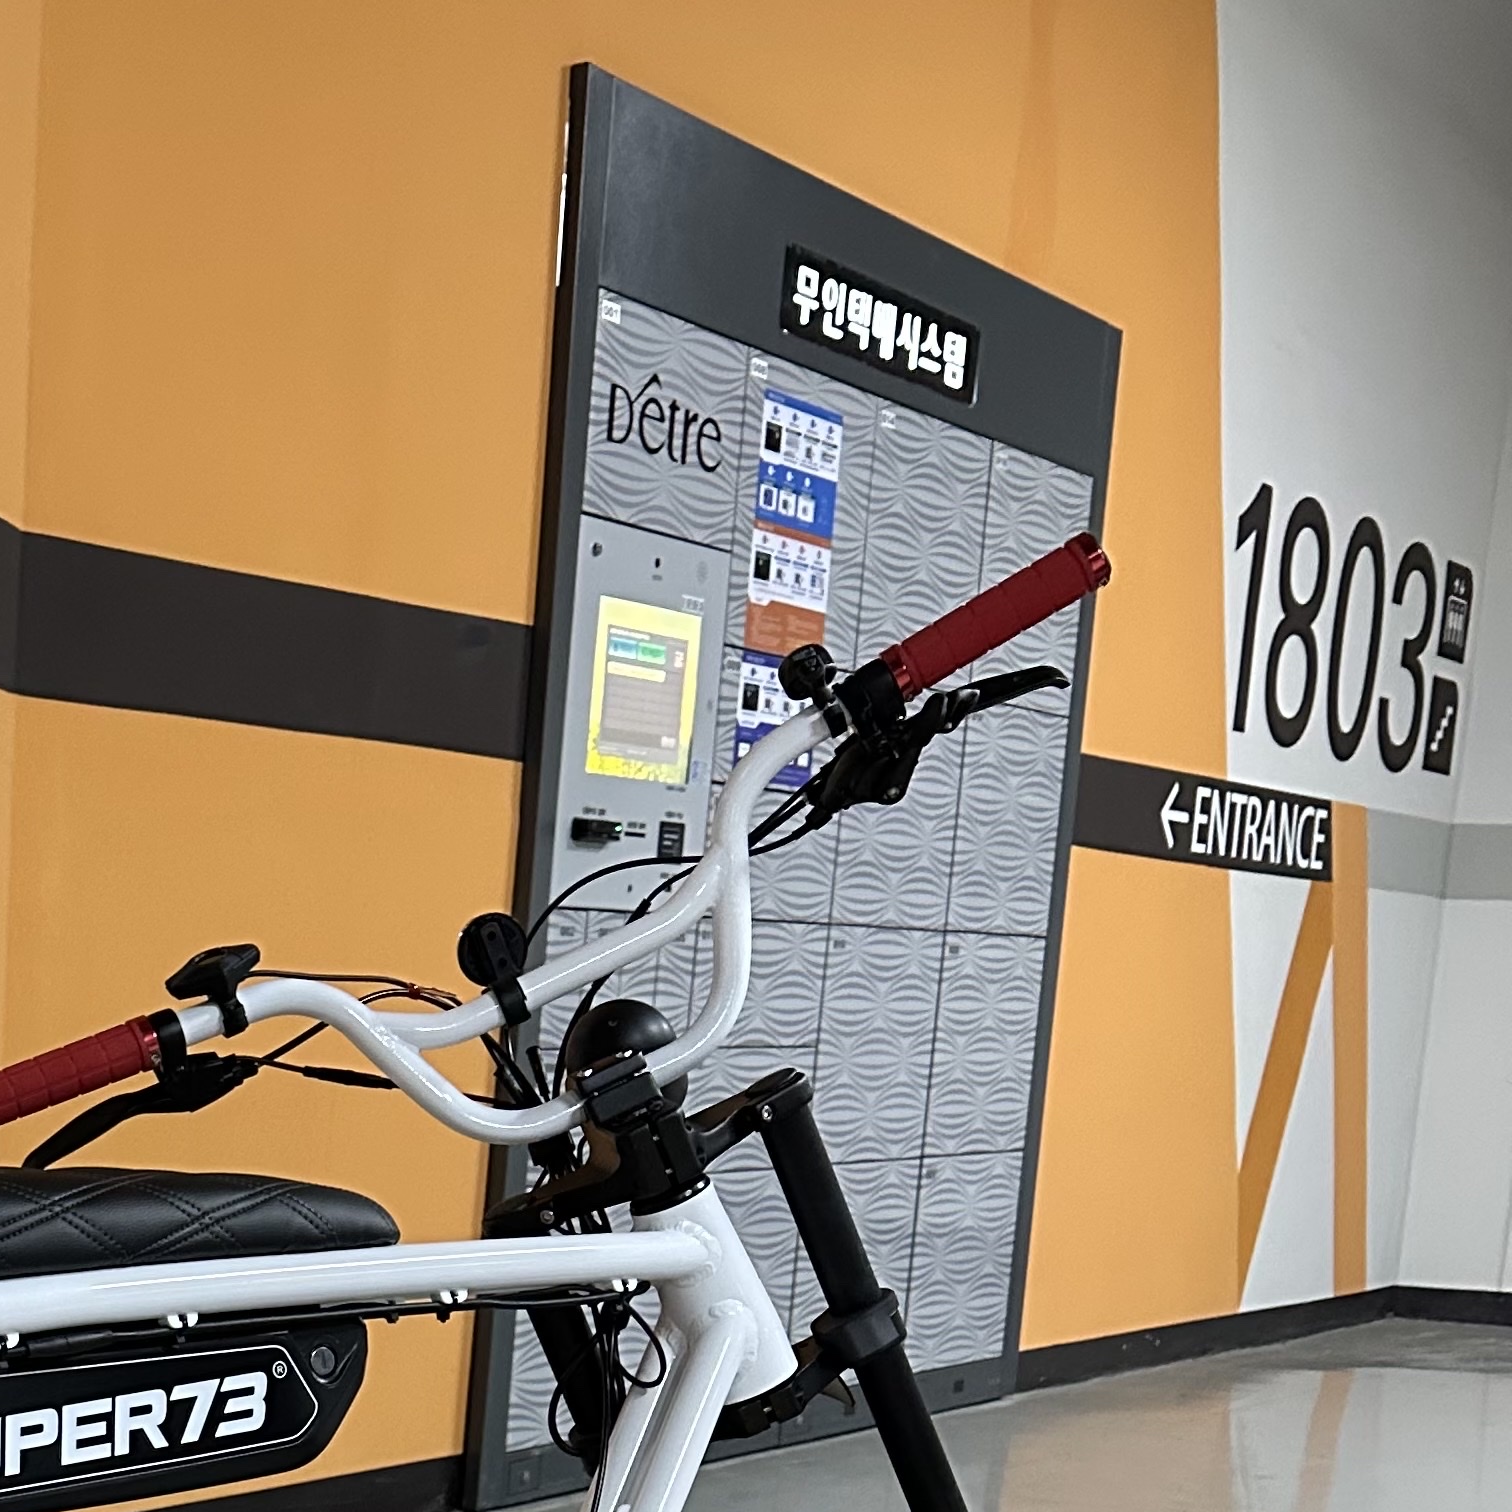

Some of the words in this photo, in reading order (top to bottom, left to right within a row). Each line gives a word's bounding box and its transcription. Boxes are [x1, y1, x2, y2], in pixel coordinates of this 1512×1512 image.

[792, 264, 967, 390] 무인택배시스템
[1232, 483, 1437, 774] 1803
[1190, 785, 1329, 870] ENTRANCE
